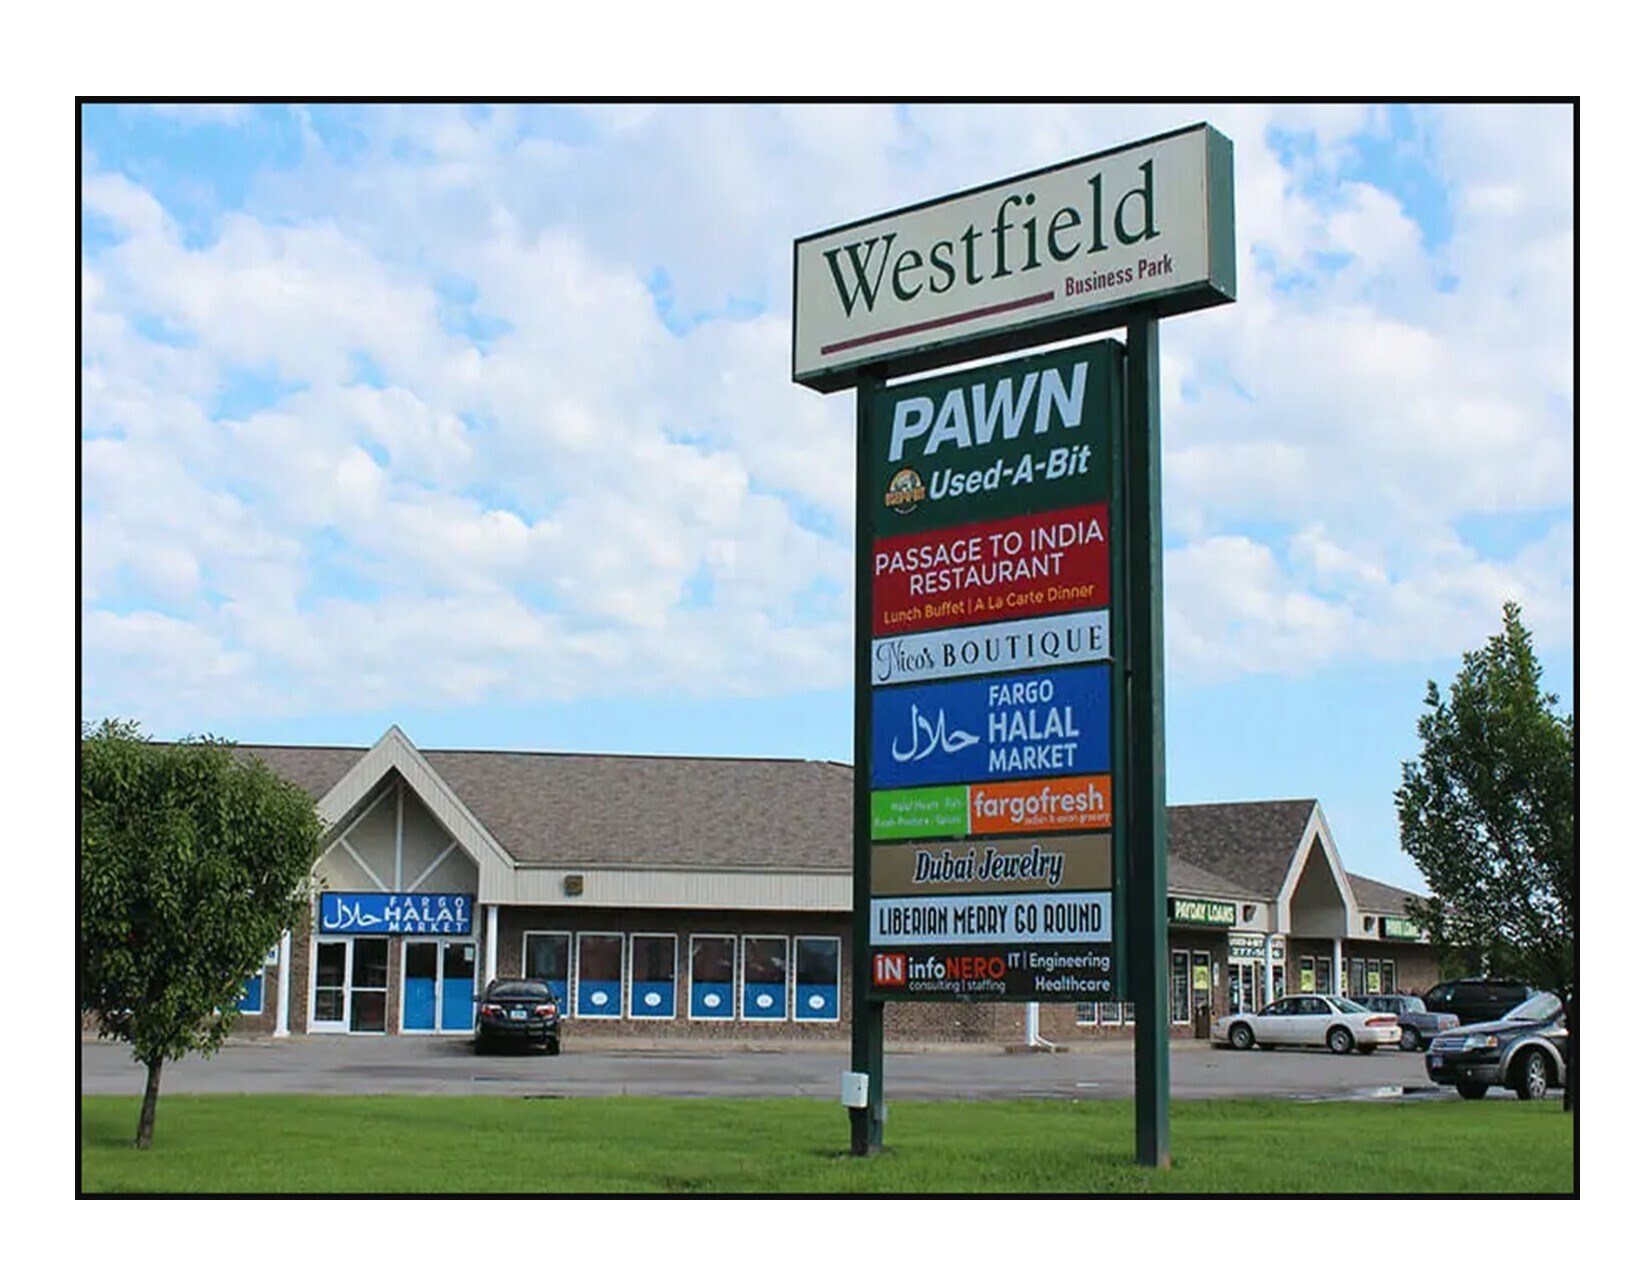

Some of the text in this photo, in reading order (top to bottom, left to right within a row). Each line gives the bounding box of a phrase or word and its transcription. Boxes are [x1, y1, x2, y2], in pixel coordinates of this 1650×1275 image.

[823, 159, 1160, 318] Westfield
[1065, 254, 1174, 298] Business Park
[888, 362, 1089, 462] PAWN
[930, 445, 1092, 499] Used-A-Bit
[875, 519, 1104, 576] PASSAGE TO INDIA
[910, 553, 1064, 596] RESTAURANT
[883, 585, 1094, 625] Lunch Buffet A La Carte Dinner
[876, 625, 1103, 682] Nico's BOUTIQUE
[989, 679, 1054, 706] FARGO
[892, 703, 980, 762] حلال
[989, 706, 1080, 744] HALAL
[989, 743, 1078, 772] MARKET
[975, 782, 1104, 824] fargofresh
[914, 844, 1063, 886] Dubai Jewelry
[384, 906, 469, 922] HALAL
[389, 896, 465, 907] FARGO
[879, 903, 1102, 935] LIBERIAN MERRY GO ROUND
[388, 921, 463, 933] MARKET
[909, 956, 1006, 979] infoNERO
[1008, 952, 1111, 972] IT Engineering
[909, 977, 1006, 993] consulting staffing
[1035, 975, 1111, 992] Healthcare
